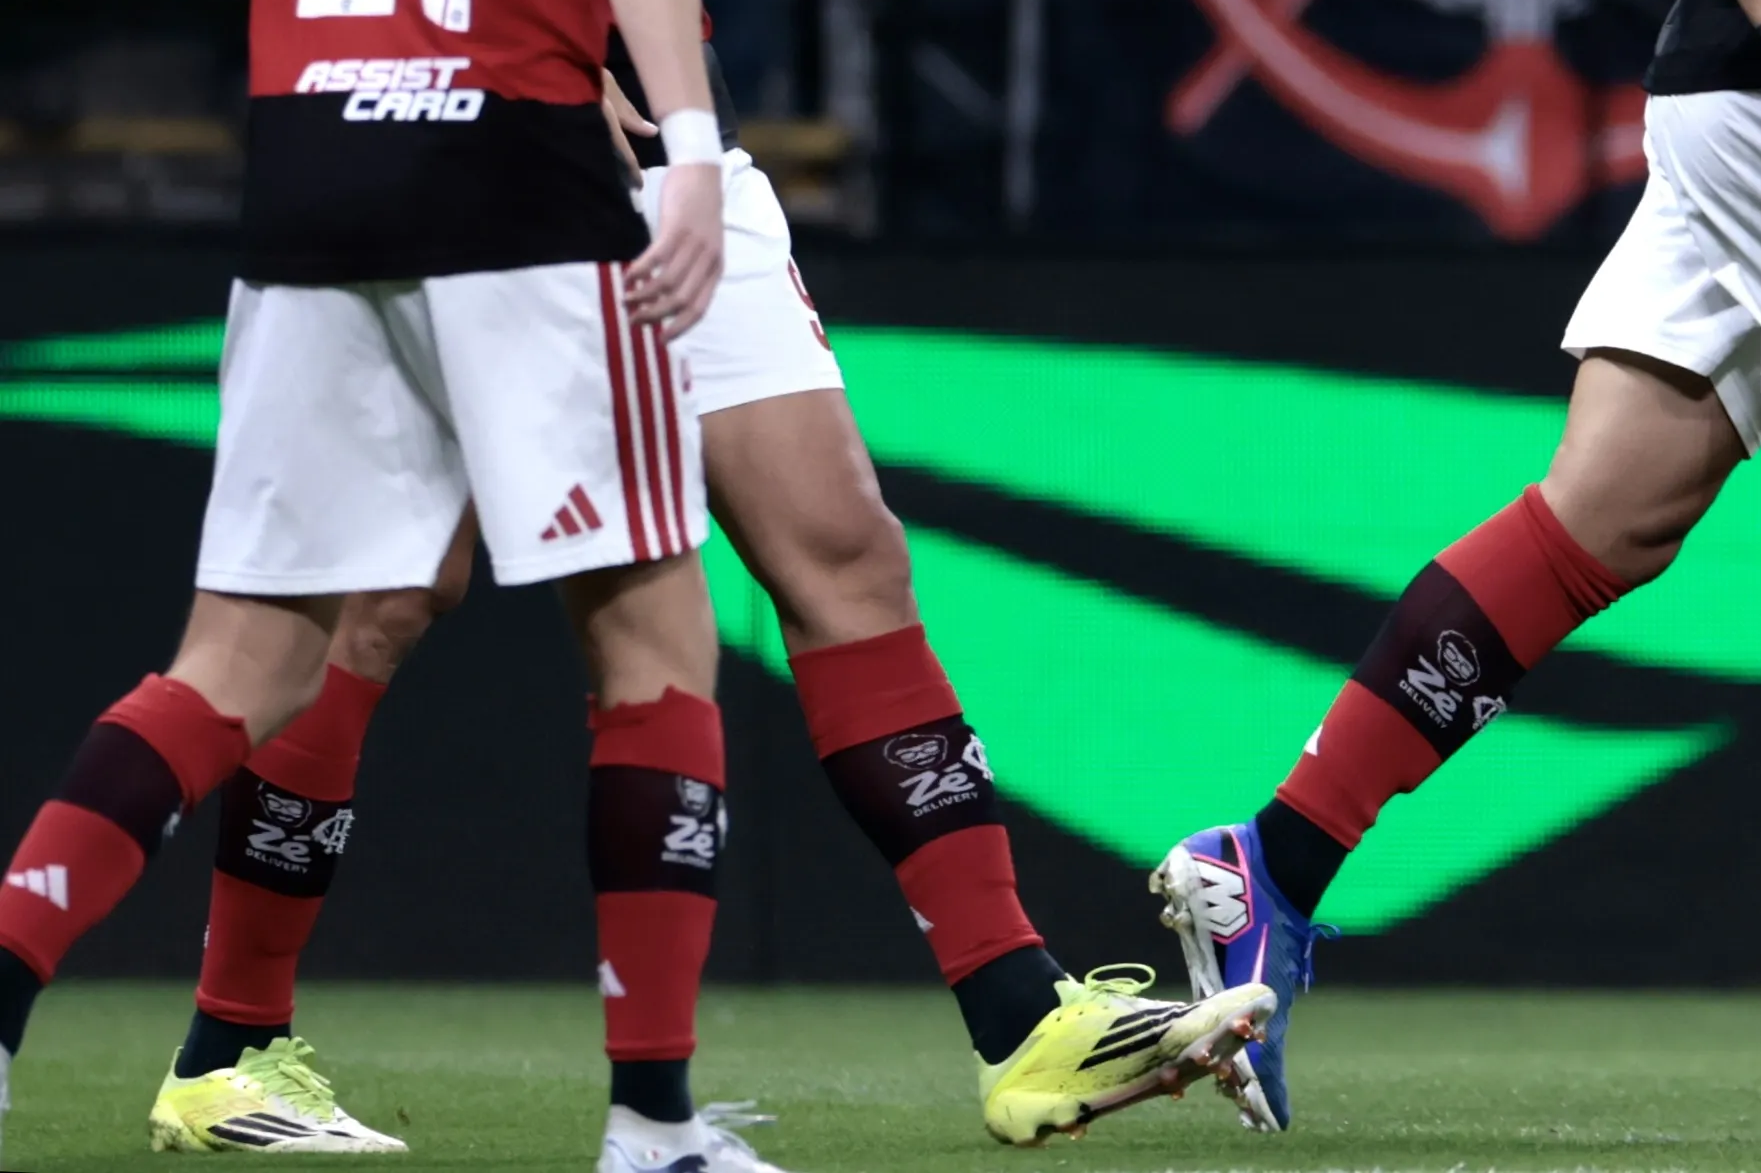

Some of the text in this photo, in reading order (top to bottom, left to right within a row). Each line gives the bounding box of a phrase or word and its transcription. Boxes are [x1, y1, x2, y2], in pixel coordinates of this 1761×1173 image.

[294, 56, 472, 93] ASSIST
[342, 88, 486, 122] CARD
[1397, 677, 1448, 729] DELIVERY
[912, 789, 980, 819] DELIVERY
[244, 846, 309, 876] DELIVERY
